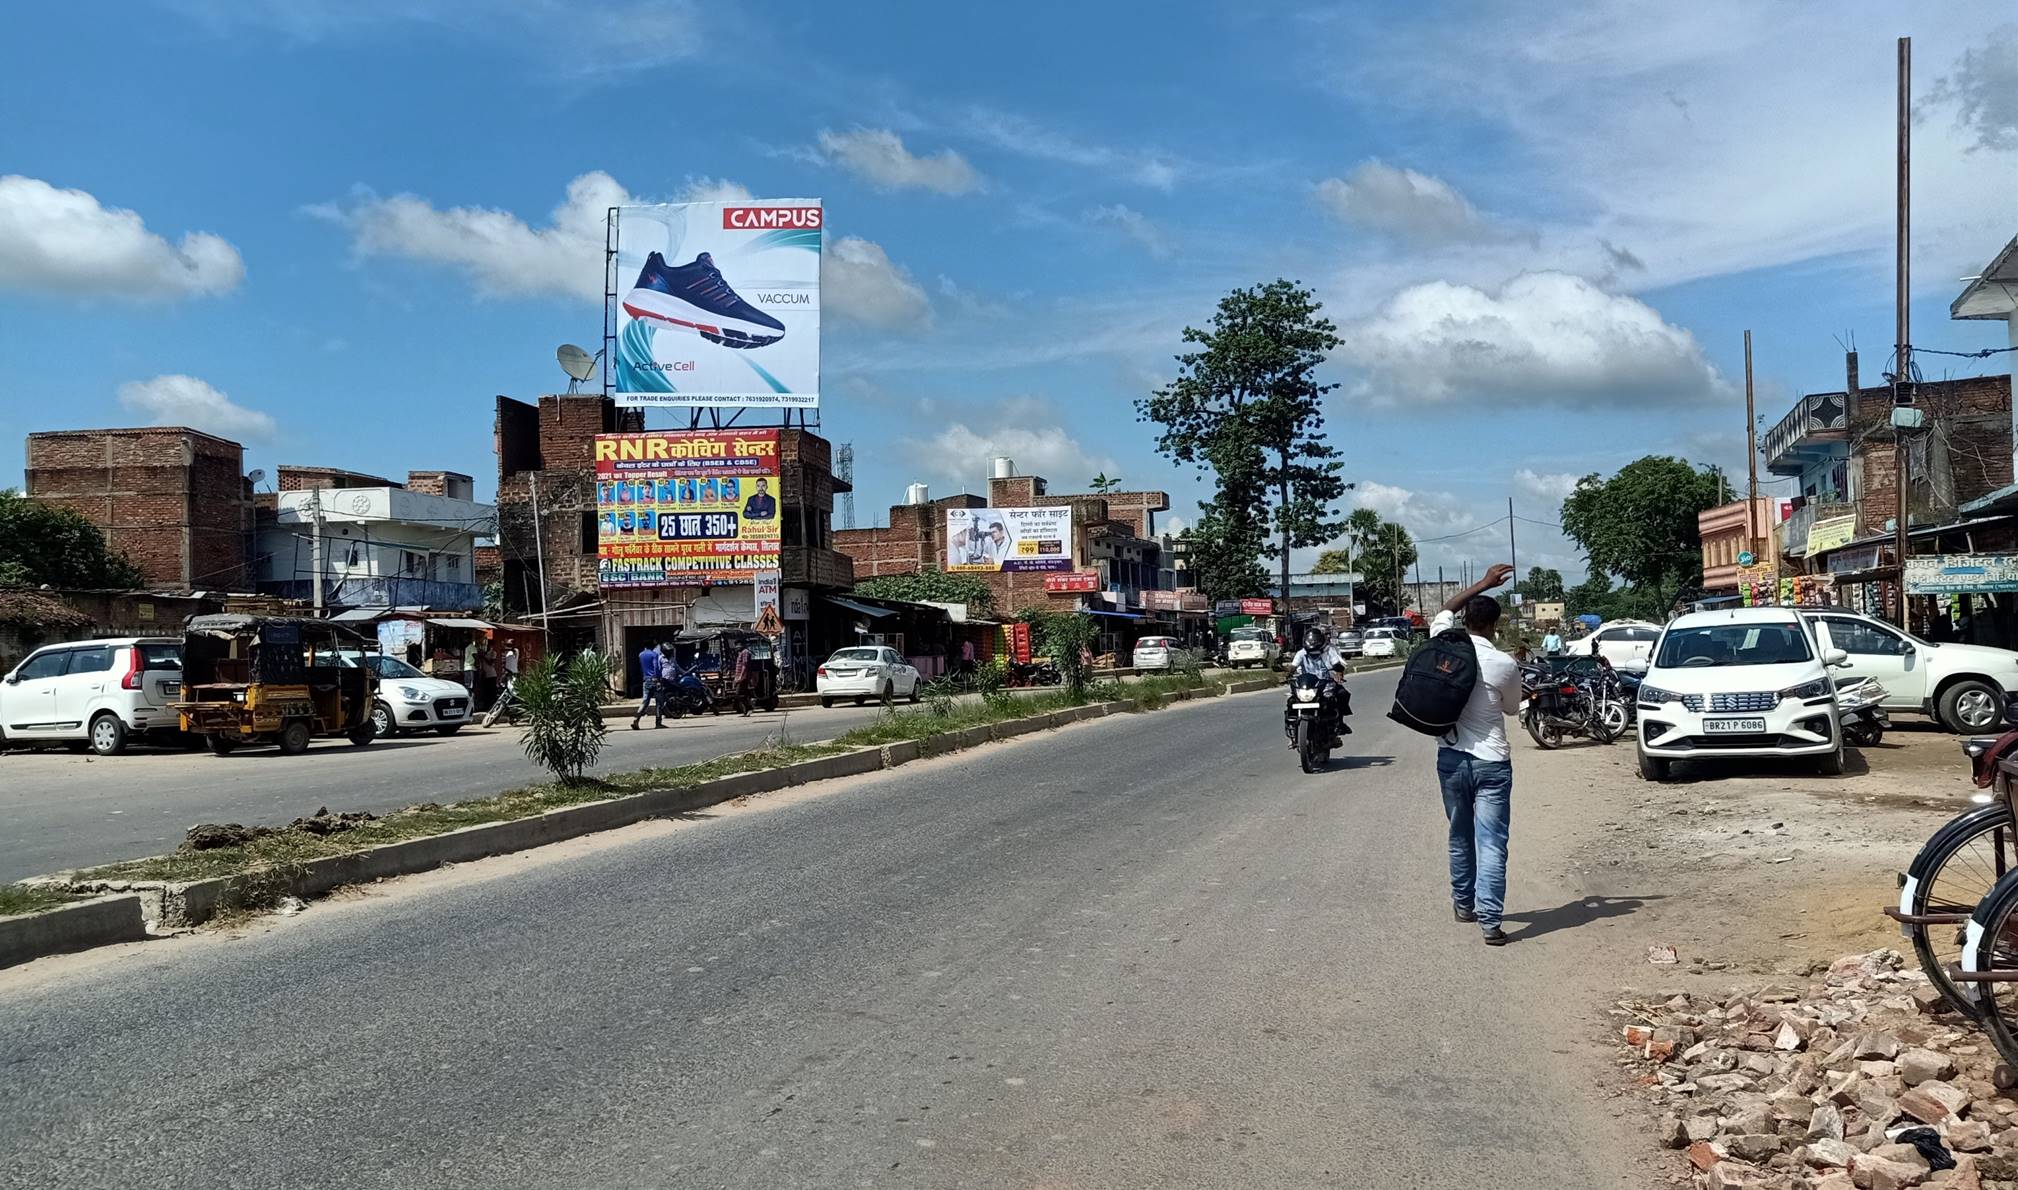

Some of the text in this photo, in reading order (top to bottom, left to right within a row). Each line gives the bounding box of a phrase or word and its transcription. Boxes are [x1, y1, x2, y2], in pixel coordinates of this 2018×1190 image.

[730, 209, 820, 227] CAMPUS
[757, 293, 810, 304] VACCUM
[596, 438, 776, 461] RNR कोचिंग सेन्टर
[647, 470, 668, 478] Result
[1048, 509, 1069, 519] साइट
[661, 516, 676, 537] 25
[705, 514, 737, 537] 350+
[612, 553, 779, 572] FASTRACK COMPETITIVE CLASSES
[1941, 554, 1997, 569] डिजिटल
[602, 573, 627, 582] SSC
[630, 572, 665, 581] BANK
[758, 586, 777, 594] ATM
[1709, 721, 1763, 730] BR21 P 6086
